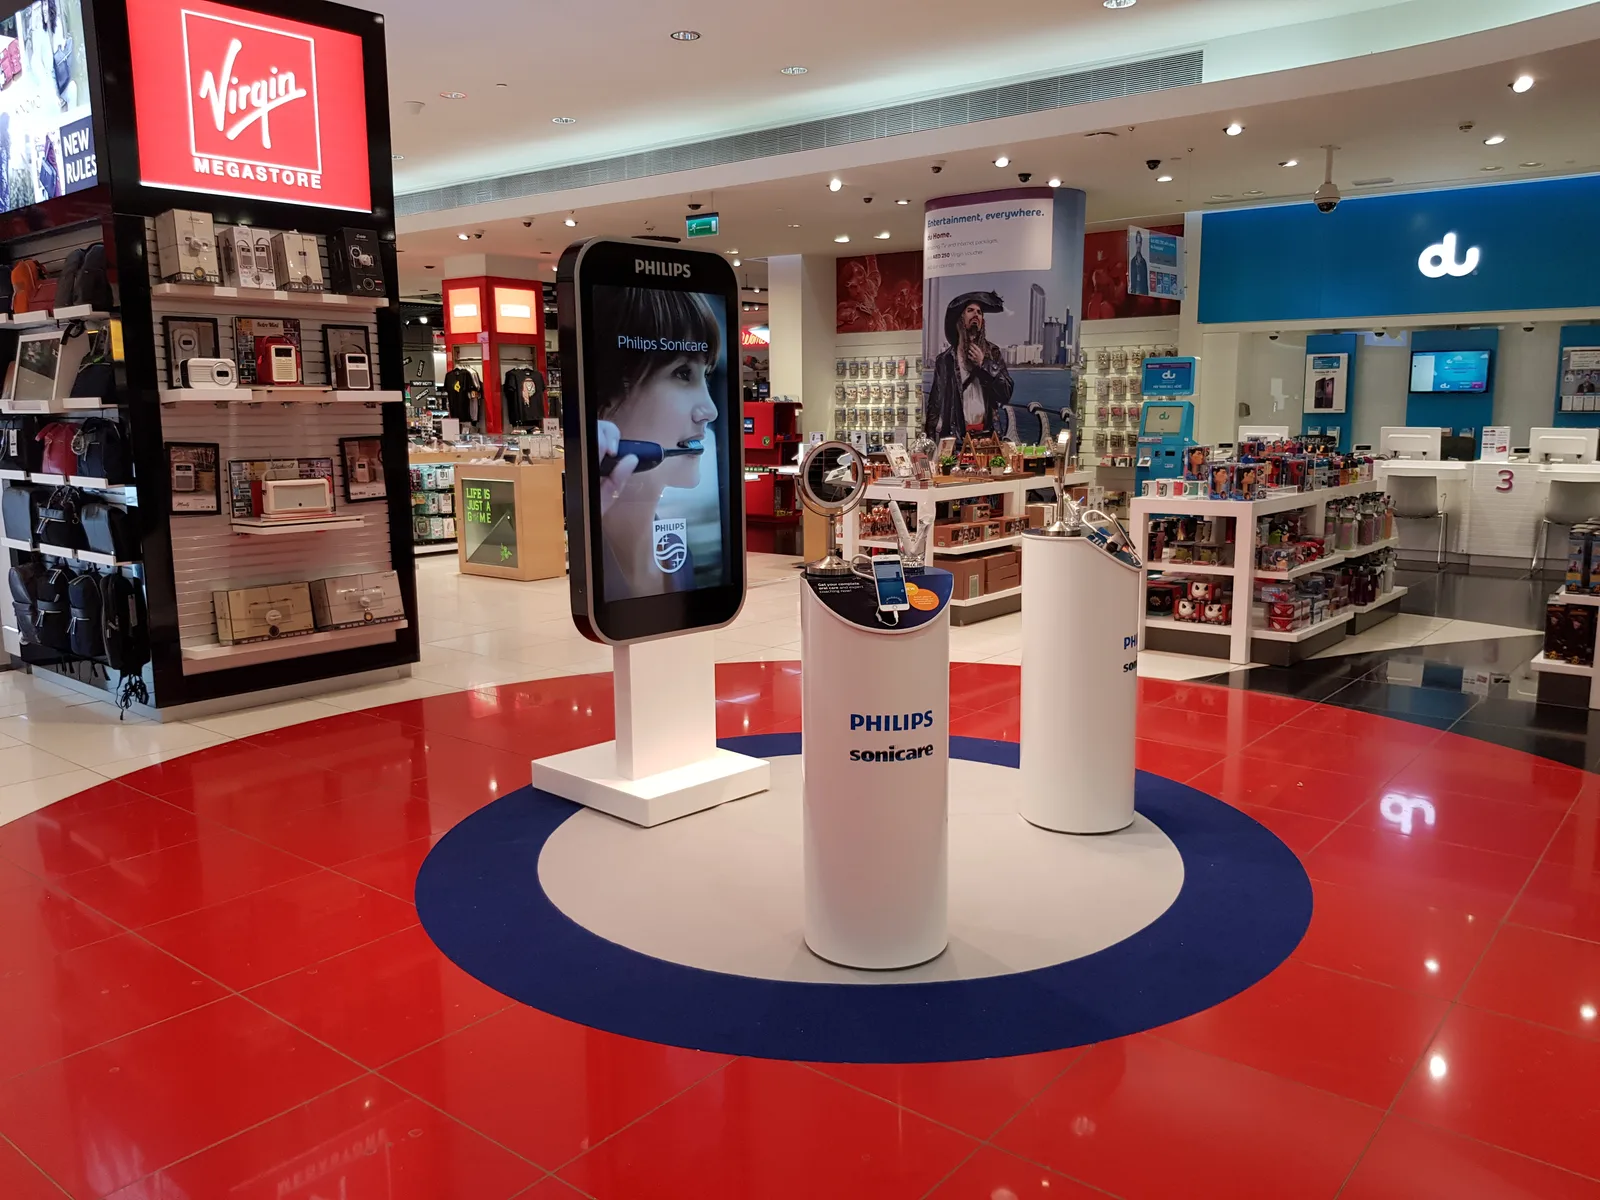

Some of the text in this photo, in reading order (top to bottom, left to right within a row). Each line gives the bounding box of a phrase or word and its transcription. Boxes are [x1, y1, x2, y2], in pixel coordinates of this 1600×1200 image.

[199, 38, 307, 149] Virgin
[63, 127, 89, 157] NEW
[66, 154, 97, 184] RULES
[193, 157, 322, 189] MEGASTORE
[927, 208, 1045, 228] Entertainment, everywhere.
[933, 231, 952, 240] Home.
[1418, 231, 1480, 278] du
[635, 259, 691, 278] PHILIPS
[618, 335, 708, 352] Philips Sonicare
[1161, 369, 1176, 380] du
[1159, 411, 1170, 420] du
[1496, 469, 1514, 492] 3
[466, 487, 491, 500] LIFE IS
[467, 499, 492, 512] JUST A
[655, 522, 685, 533] PHILIPS
[850, 709, 934, 731] PHILIPS
[849, 743, 934, 762] sonicare
